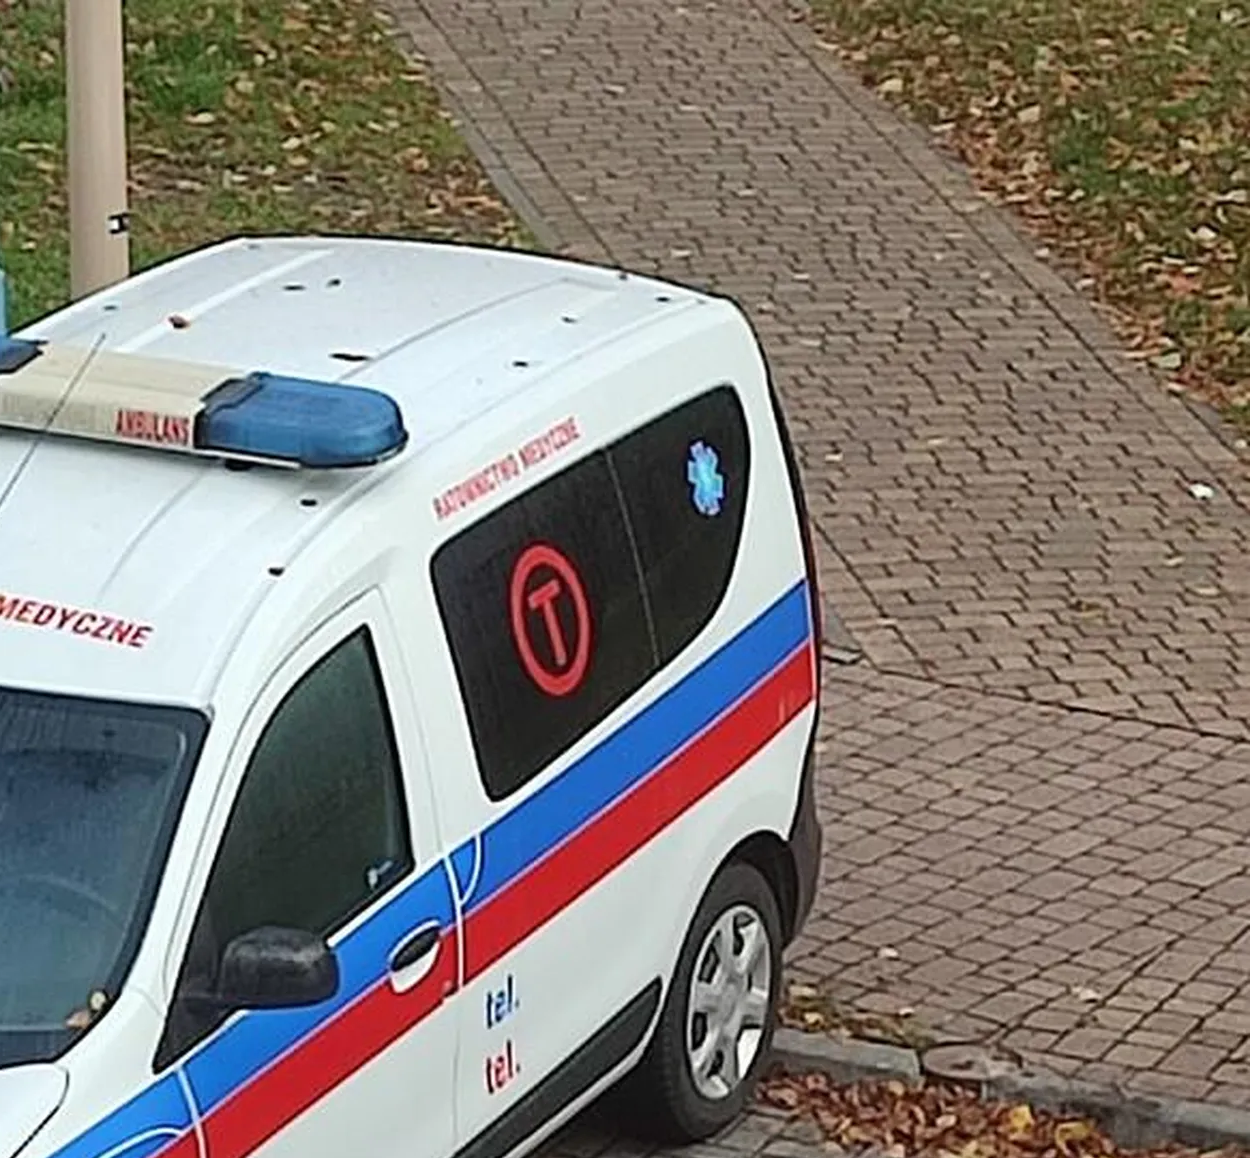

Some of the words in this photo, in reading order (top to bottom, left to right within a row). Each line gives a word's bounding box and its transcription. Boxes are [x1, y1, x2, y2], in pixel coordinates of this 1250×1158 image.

[115, 408, 191, 446] AMBULANS
[432, 453, 520, 521] RATOWNICTWO
[518, 416, 580, 470] MEDYCZNE
[528, 578, 567, 667] T
[485, 973, 520, 1030] tel.
[485, 1037, 521, 1095] tel.
